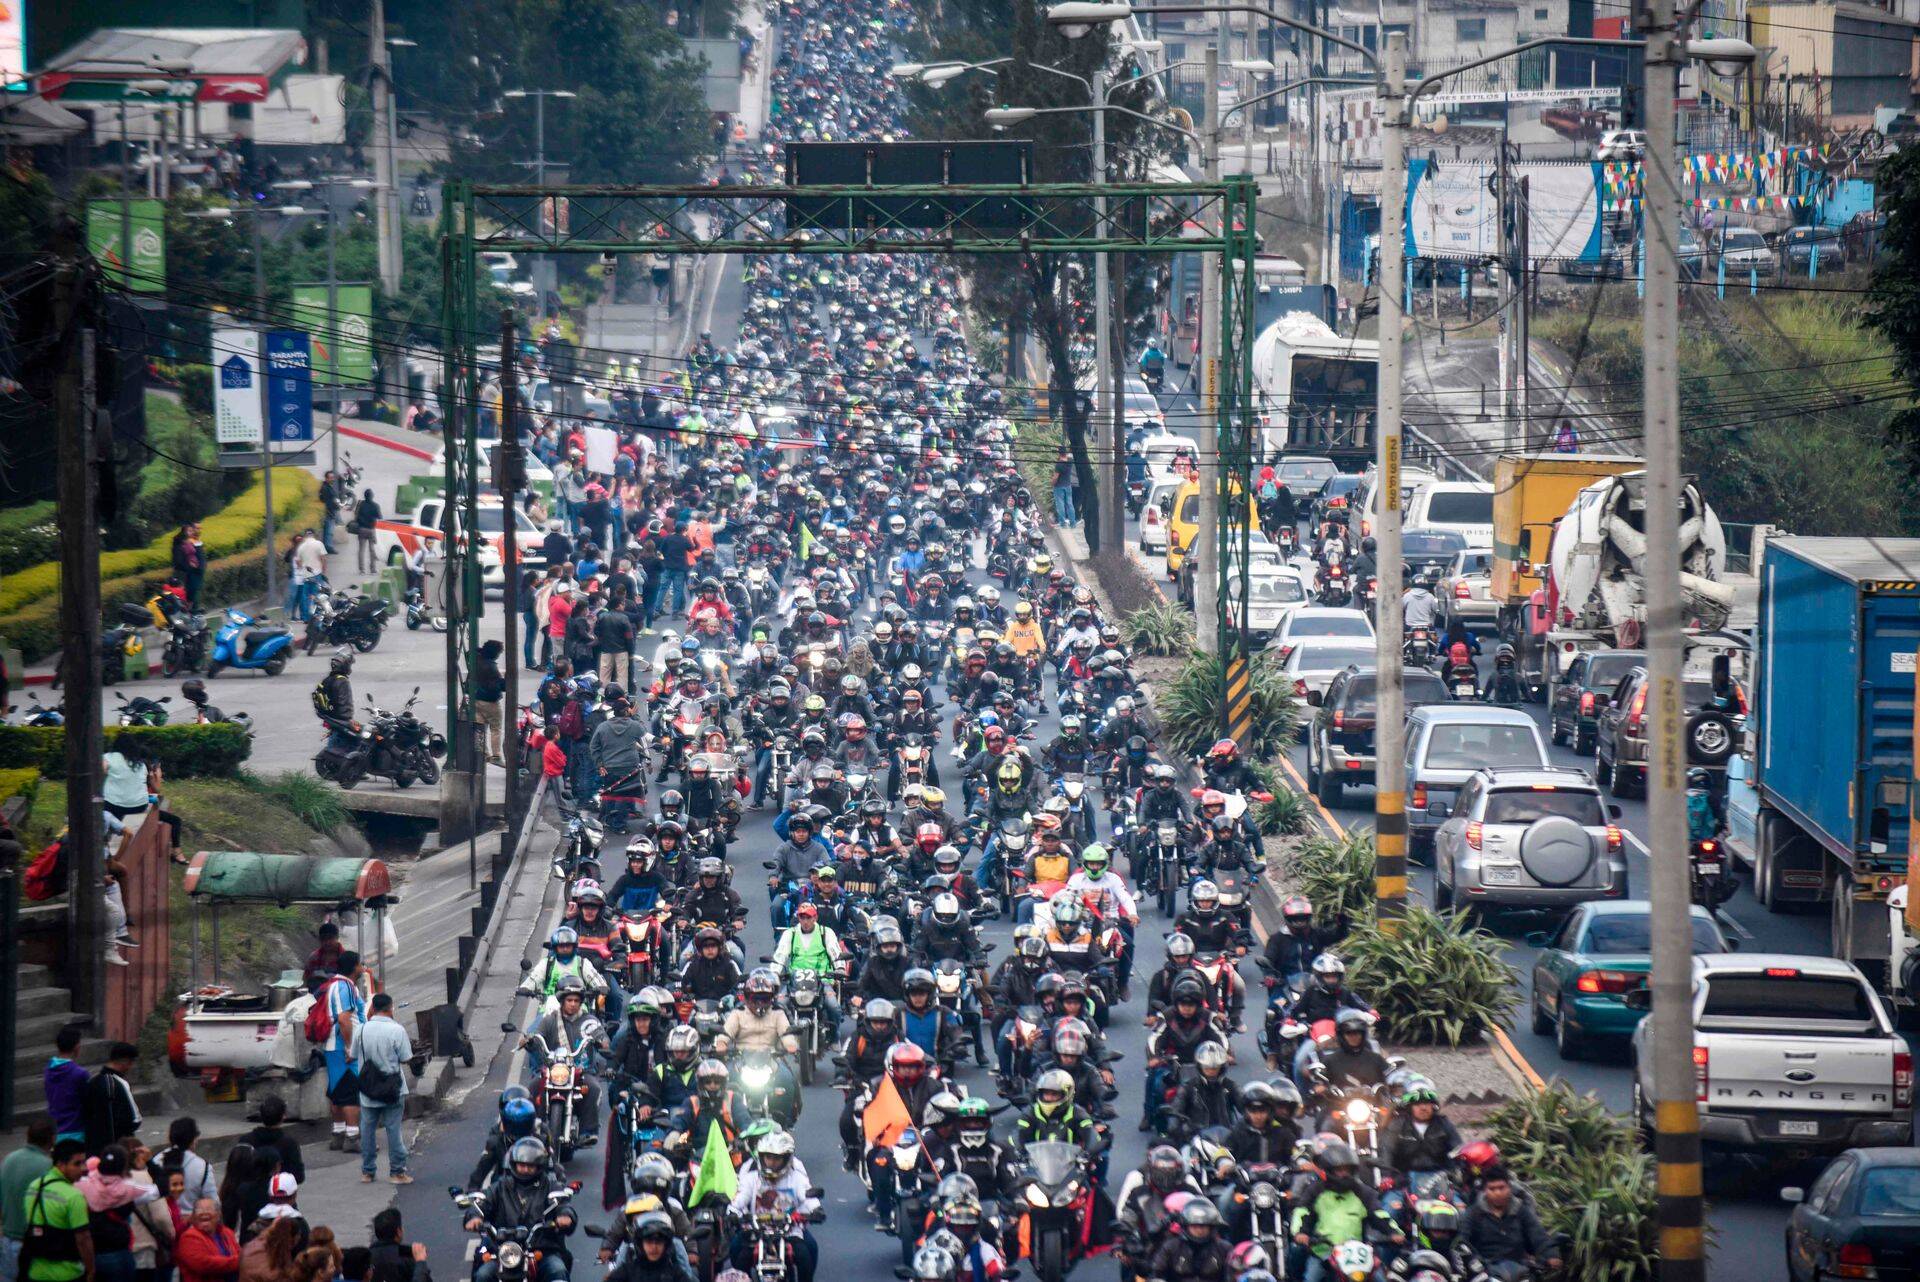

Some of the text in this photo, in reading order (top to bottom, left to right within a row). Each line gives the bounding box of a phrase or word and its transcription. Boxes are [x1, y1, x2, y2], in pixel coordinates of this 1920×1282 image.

[1459, 93, 1500, 101] ESTILOS
[1531, 89, 1575, 98] MEJORES
[1577, 88, 1619, 96] PRECIOS
[795, 968, 815, 982] 52
[1717, 1087, 1887, 1103] RANGER
[1343, 1247, 1368, 1265] 29
